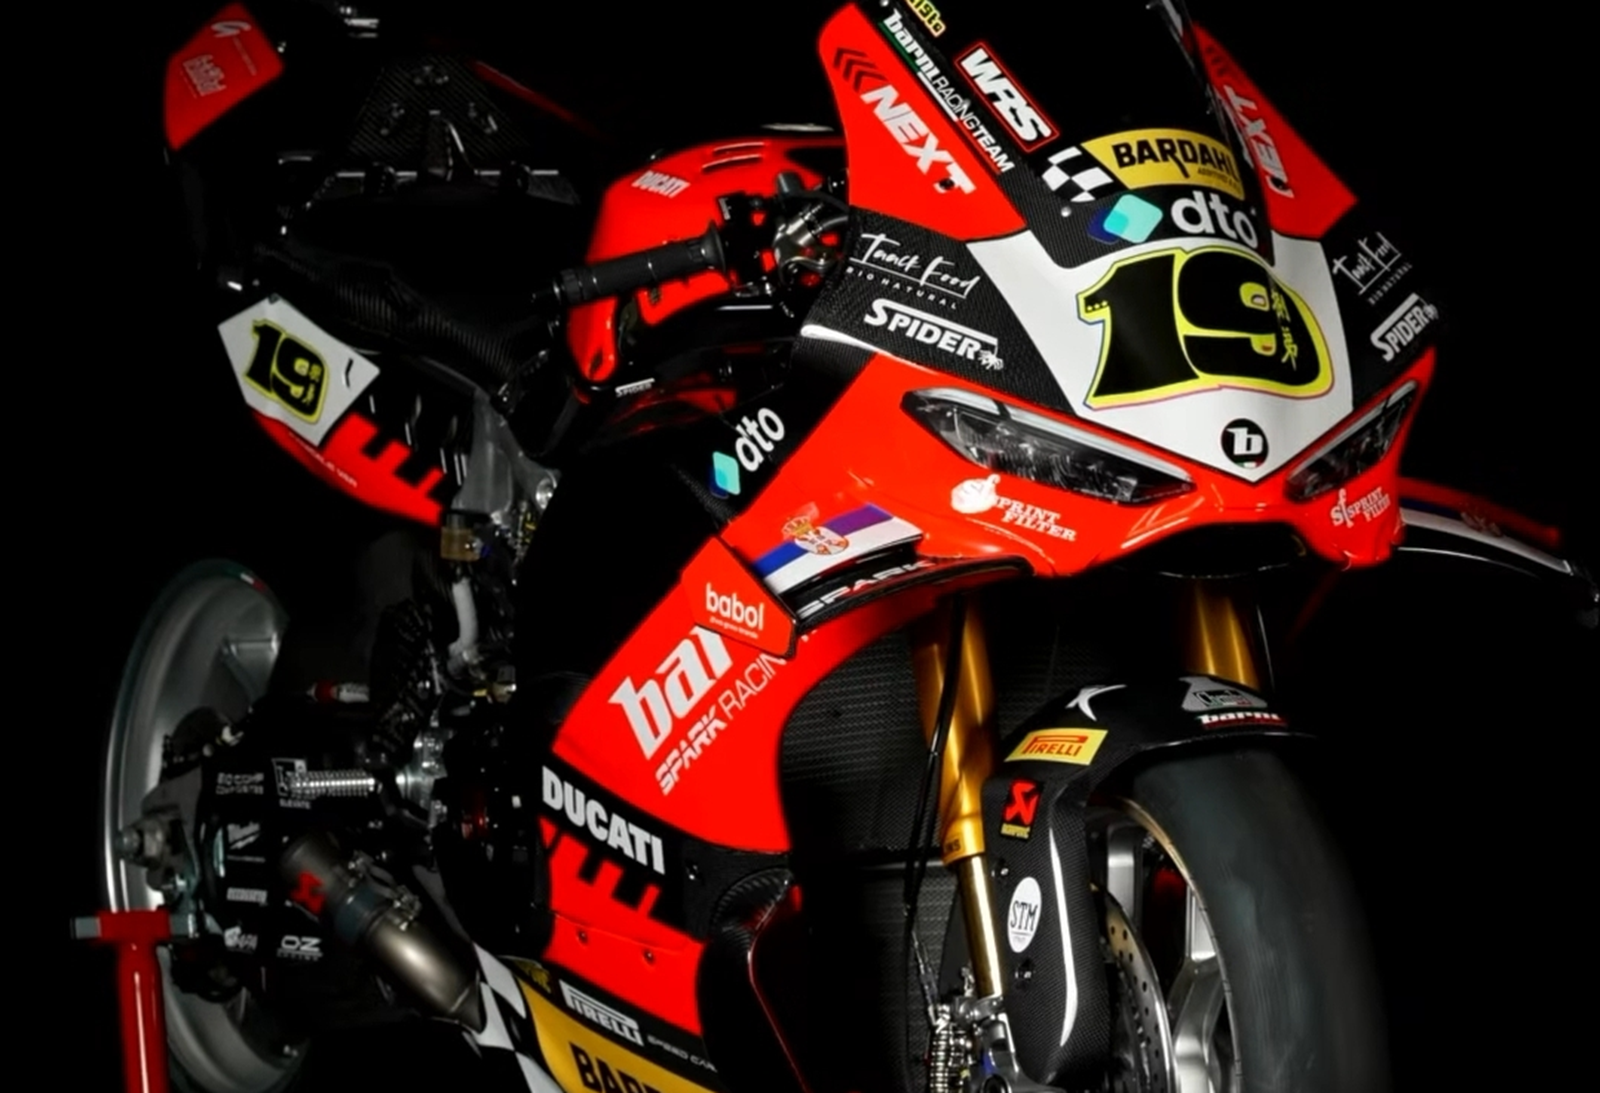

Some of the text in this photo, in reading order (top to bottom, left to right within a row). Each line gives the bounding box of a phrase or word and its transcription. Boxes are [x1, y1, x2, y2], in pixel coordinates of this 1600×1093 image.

[960, 47, 1052, 141] WRS
[860, 84, 977, 194] NEXT
[1111, 138, 1240, 182] BARDAHL
[631, 170, 691, 198] DUCATI
[1170, 190, 1258, 249] dto
[881, 277, 957, 310] NATURAL
[919, 256, 981, 298] Food
[864, 298, 998, 360] SPIDER
[1076, 245, 1334, 411] 19
[1370, 293, 1430, 362] SPIDER
[243, 318, 329, 425] 19
[735, 407, 785, 472] dto
[1002, 510, 1077, 542] FILTER
[706, 582, 764, 631] babol
[655, 704, 728, 796] SPARK
[1022, 735, 1088, 757] PIRELLI
[542, 765, 665, 875] DUCATI
[281, 934, 321, 952] OZ
[1010, 901, 1038, 932] STM
[559, 979, 644, 1047] PIRELLI
